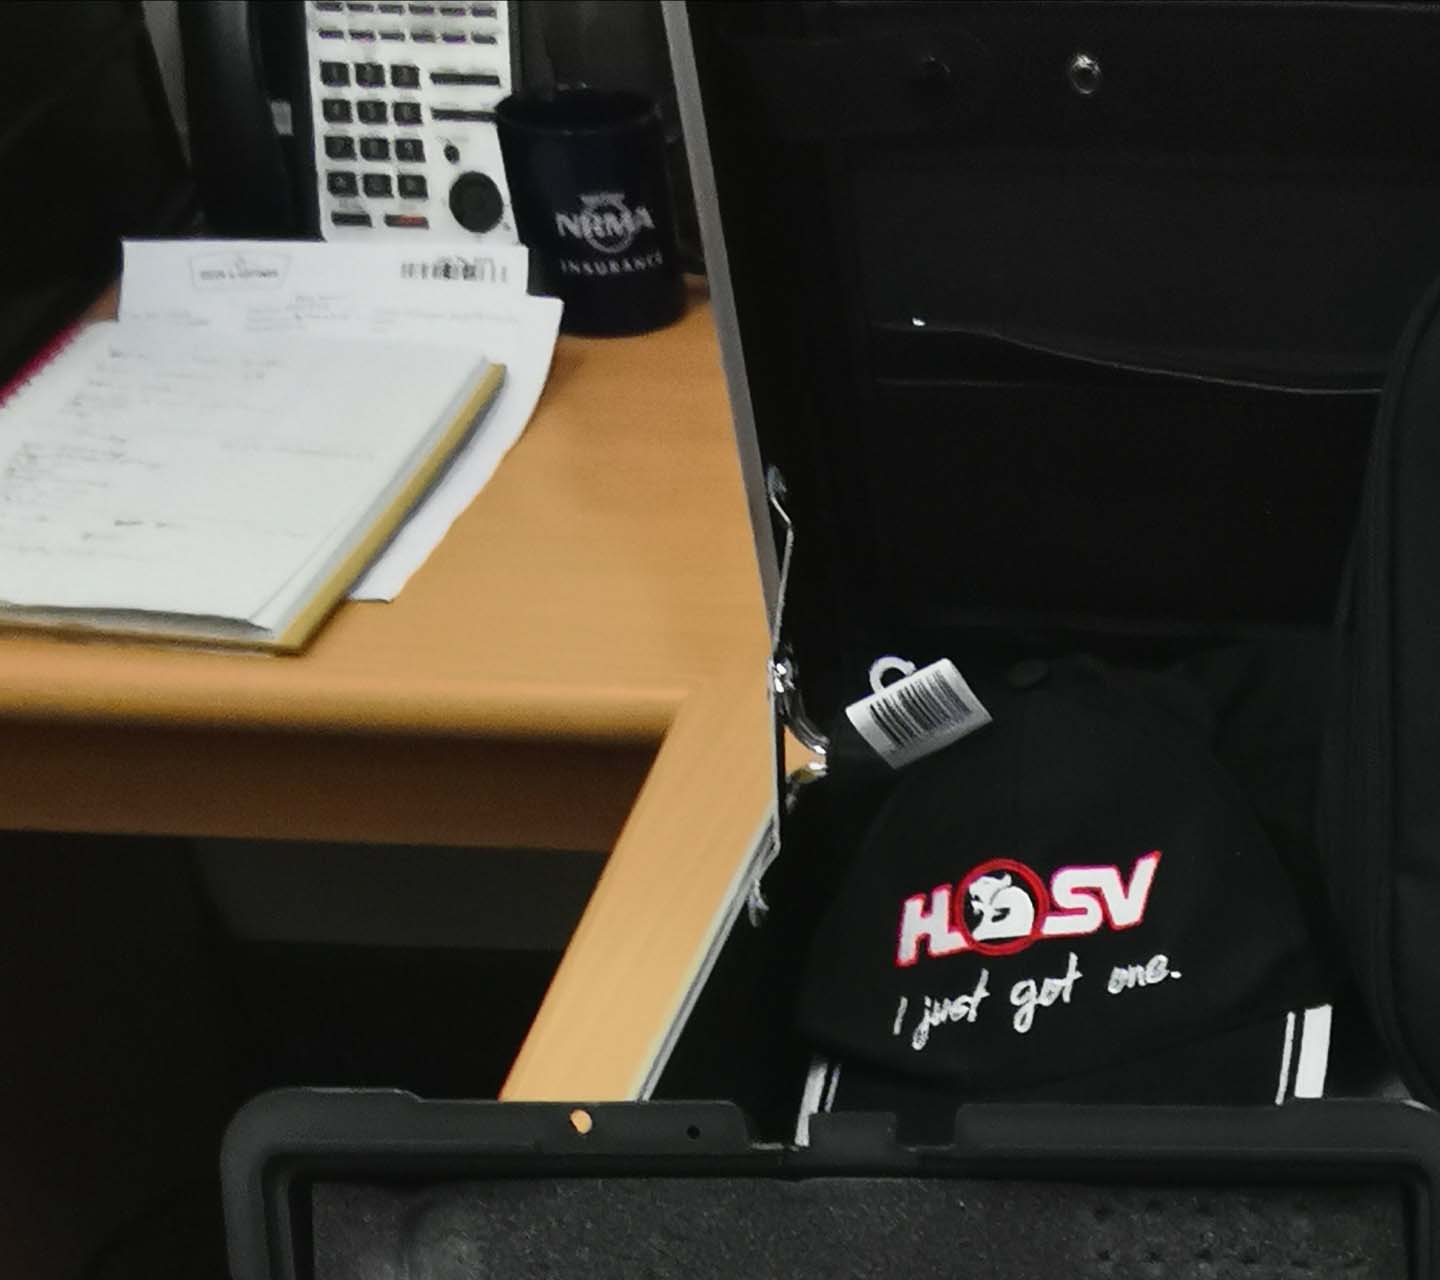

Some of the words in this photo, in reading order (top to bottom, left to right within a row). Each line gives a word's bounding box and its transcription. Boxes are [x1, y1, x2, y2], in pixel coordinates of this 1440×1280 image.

[913, 969, 989, 1050] just
[1010, 953, 1081, 1032] got
[1108, 954, 1181, 994] one.
